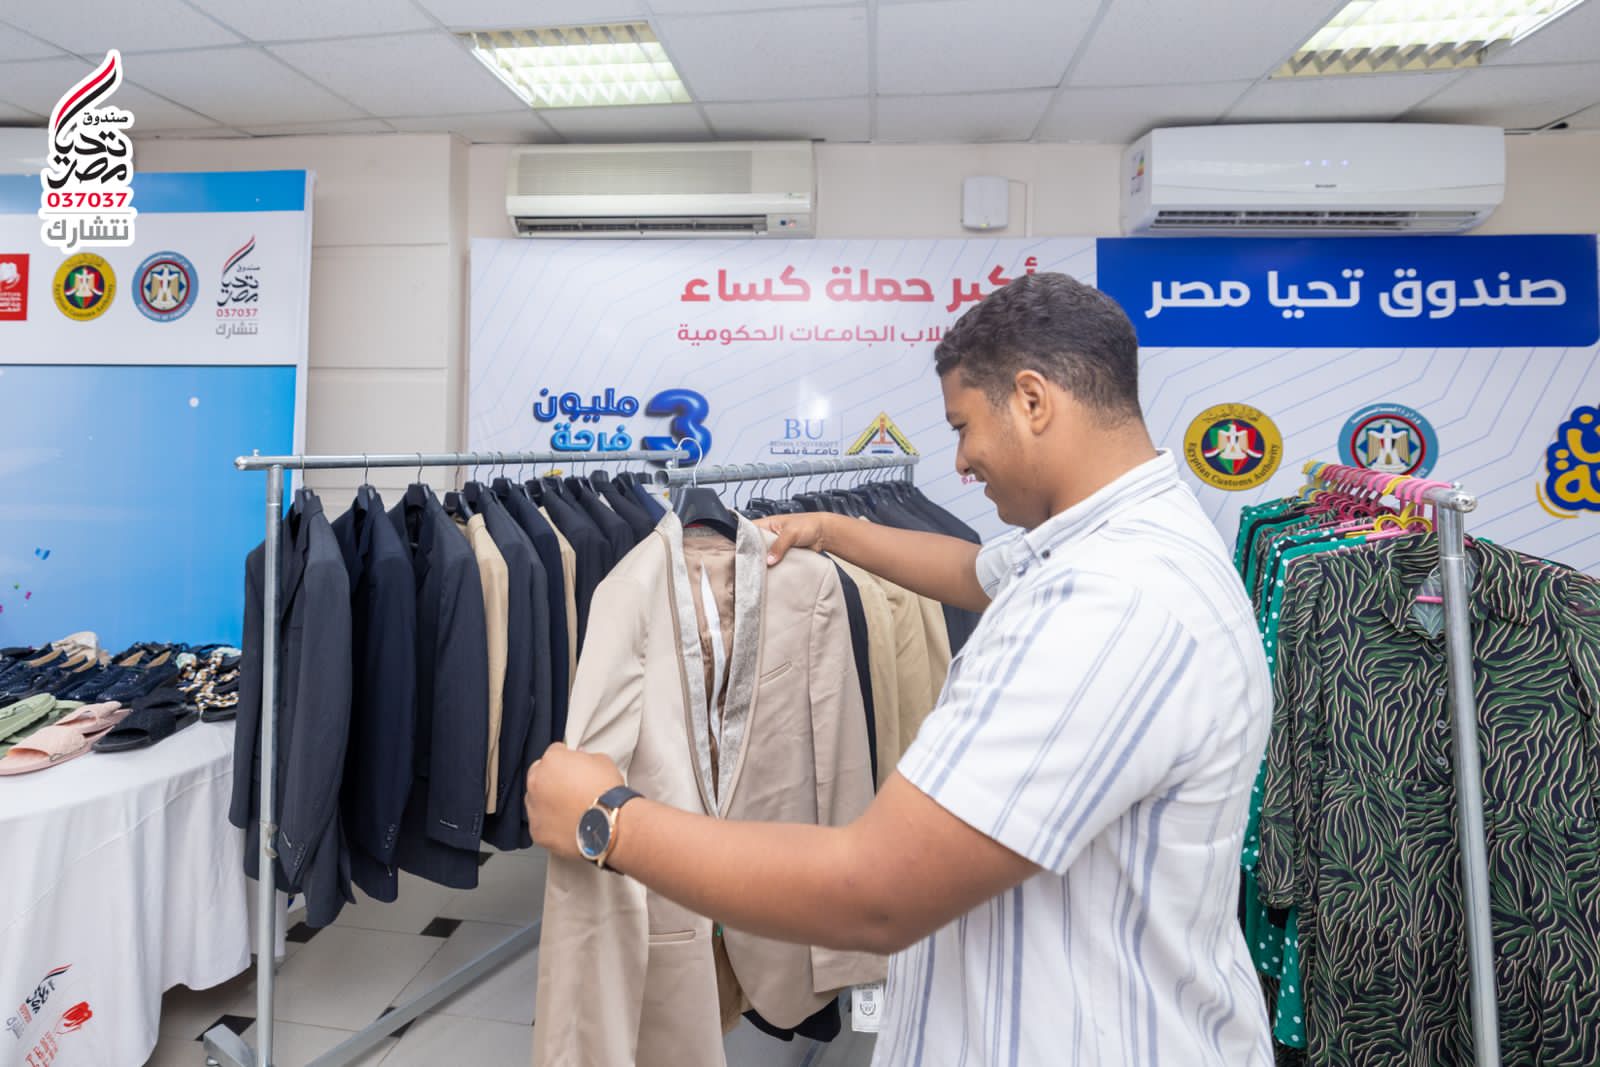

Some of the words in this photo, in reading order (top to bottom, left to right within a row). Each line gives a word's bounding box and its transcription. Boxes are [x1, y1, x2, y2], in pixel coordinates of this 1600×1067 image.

[680, 264, 812, 302] كساء
[825, 265, 935, 302] حملة
[1145, 280, 1250, 319] مصر
[1267, 268, 1364, 319] تحيا
[1379, 267, 1567, 319] صندوق
[216, 308, 259, 318] 037037
[677, 323, 784, 346] الحكومية
[789, 324, 895, 347] الجامعات
[901, 325, 950, 348] لاب
[533, 387, 639, 422] مليون
[783, 418, 824, 440] BU
[1187, 442, 1212, 479] Egyptian
[1211, 474, 1253, 487] Customs
[1254, 443, 1281, 481] Authority
